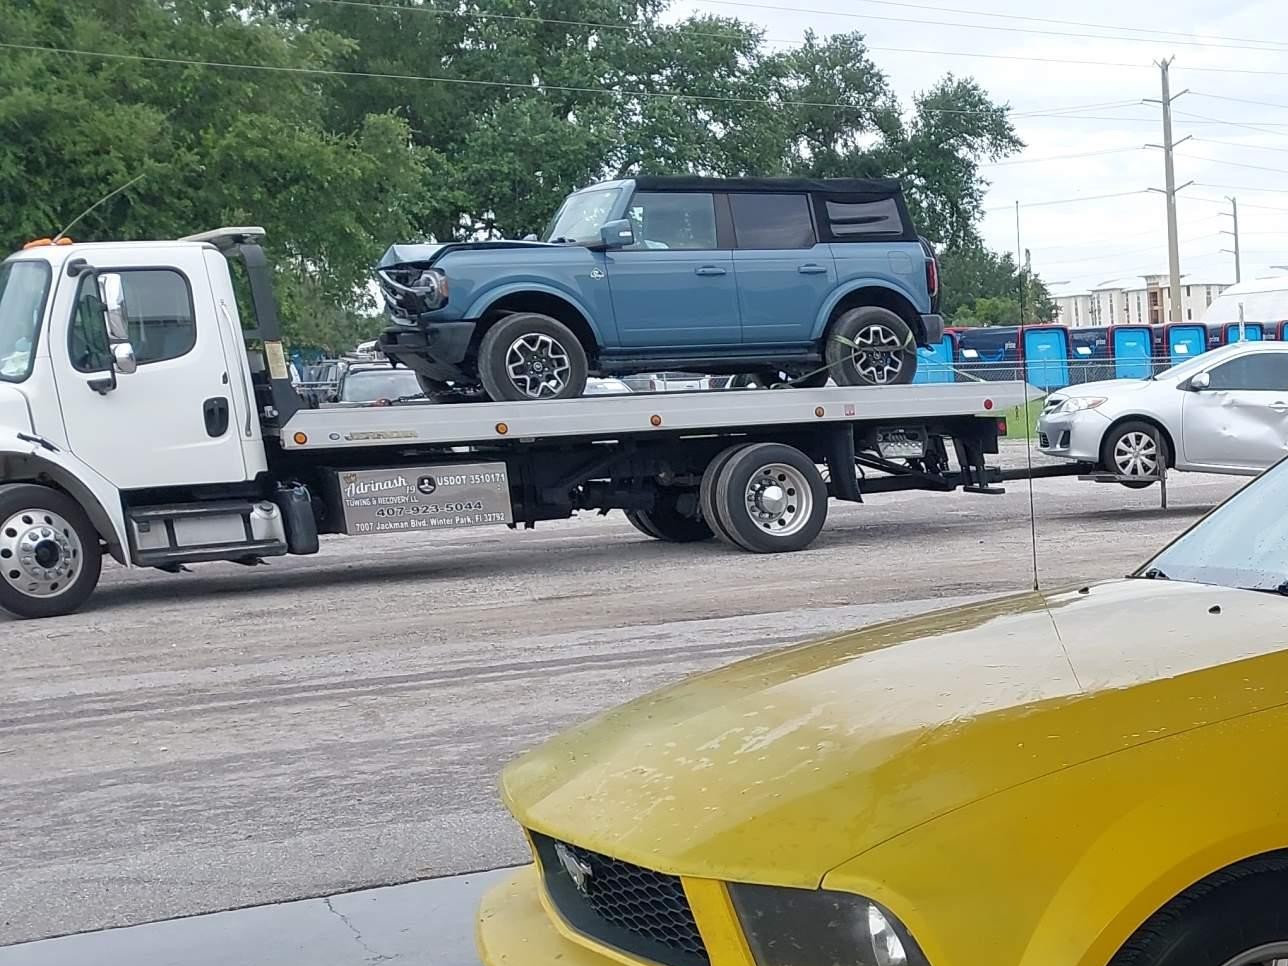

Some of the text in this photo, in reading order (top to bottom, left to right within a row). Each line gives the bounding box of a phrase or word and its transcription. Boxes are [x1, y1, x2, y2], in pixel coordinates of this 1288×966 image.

[344, 475, 407, 497] Adrinash
[437, 473, 505, 486] USDOT 3510171
[345, 498, 371, 507] TOWING
[378, 495, 409, 505] RECOVERY
[376, 500, 483, 518] 407-923-5044
[355, 522, 374, 532] 7007
[376, 520, 409, 530] Jackman
[429, 517, 453, 526] Winter
[484, 512, 505, 522] 32792
